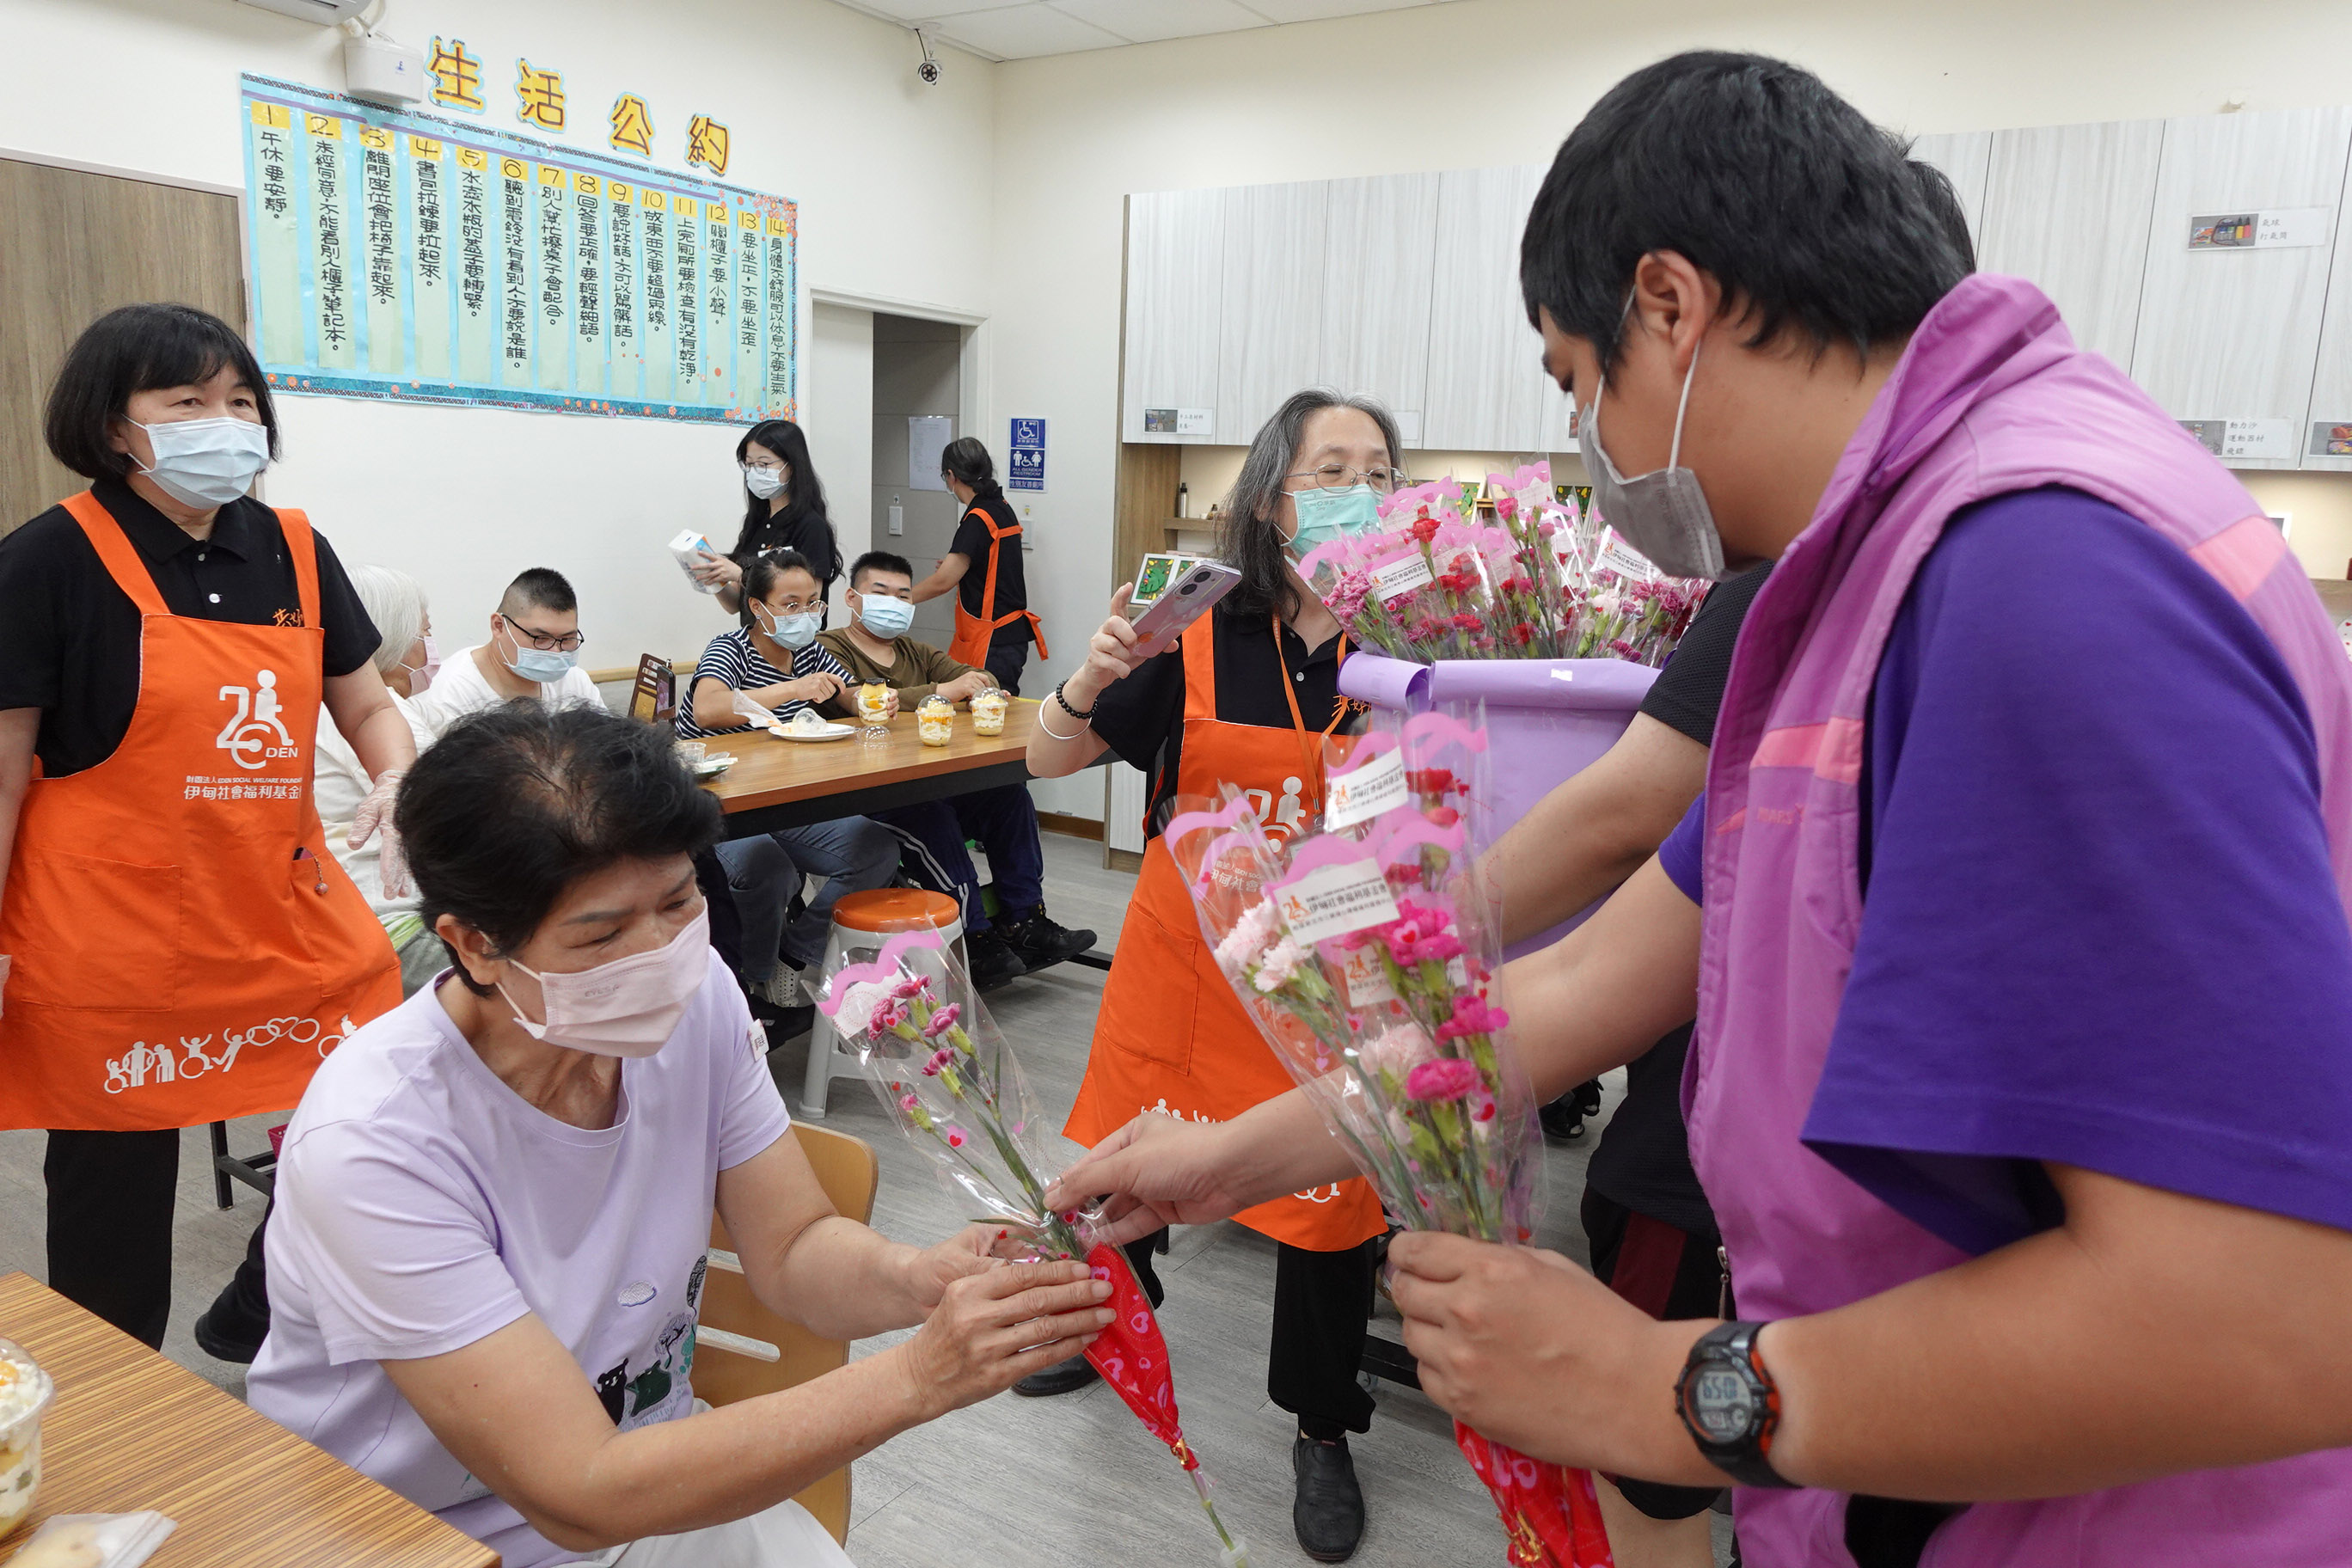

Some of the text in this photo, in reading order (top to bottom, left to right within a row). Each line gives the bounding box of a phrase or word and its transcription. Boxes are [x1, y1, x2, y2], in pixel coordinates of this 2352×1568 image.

[266, 104, 273, 126] 1
[310, 115, 334, 136] 2
[364, 128, 386, 148] 3
[416, 137, 438, 157] 4
[461, 150, 480, 167] 5
[260, 132, 287, 219] 午休要安靜。
[504, 159, 522, 178] 6
[542, 168, 560, 184] 7
[579, 175, 596, 193] 8
[612, 183, 628, 201] 9
[644, 191, 663, 208] 10
[677, 198, 694, 215] 11
[708, 205, 726, 221] 12
[739, 212, 756, 230] 13
[365, 150, 395, 304] 離開座位會把椅子靠起來。
[769, 218, 786, 235] 14
[643, 210, 666, 333] 放東西不要超過界線。
[708, 224, 728, 325] 關櫃子要小聲。
[676, 217, 697, 385] 上完廁所要檢查有沒有乾淨。
[184, 785, 303, 800] 伊甸社會福利基金
